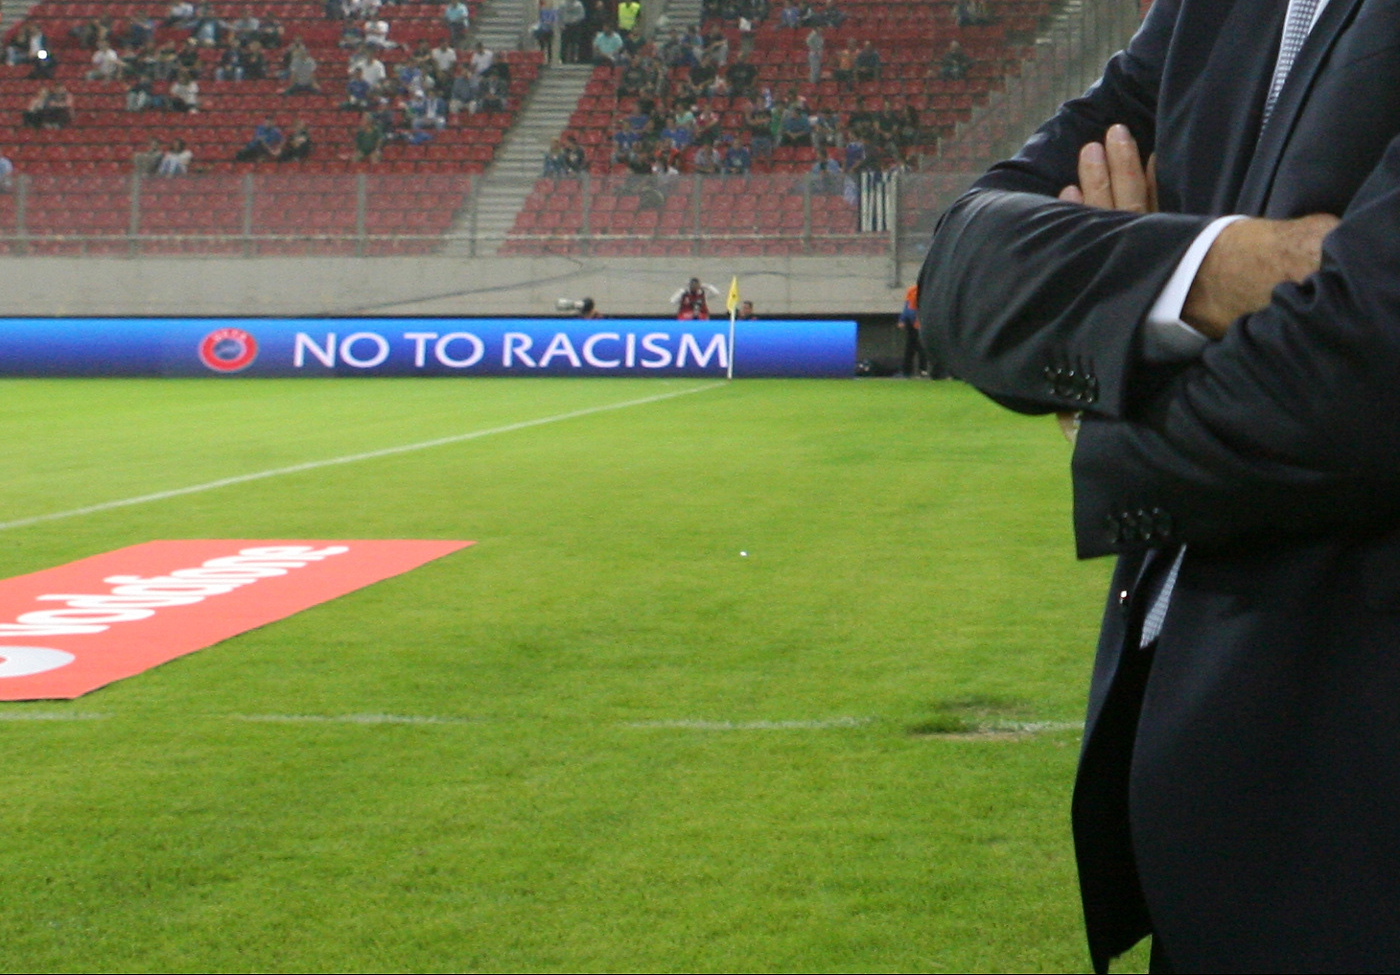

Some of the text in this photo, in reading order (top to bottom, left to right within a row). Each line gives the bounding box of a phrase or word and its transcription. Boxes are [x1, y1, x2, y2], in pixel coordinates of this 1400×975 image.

[292, 331, 731, 369] NO TO RACISM
[0, 545, 350, 637] vodafone
